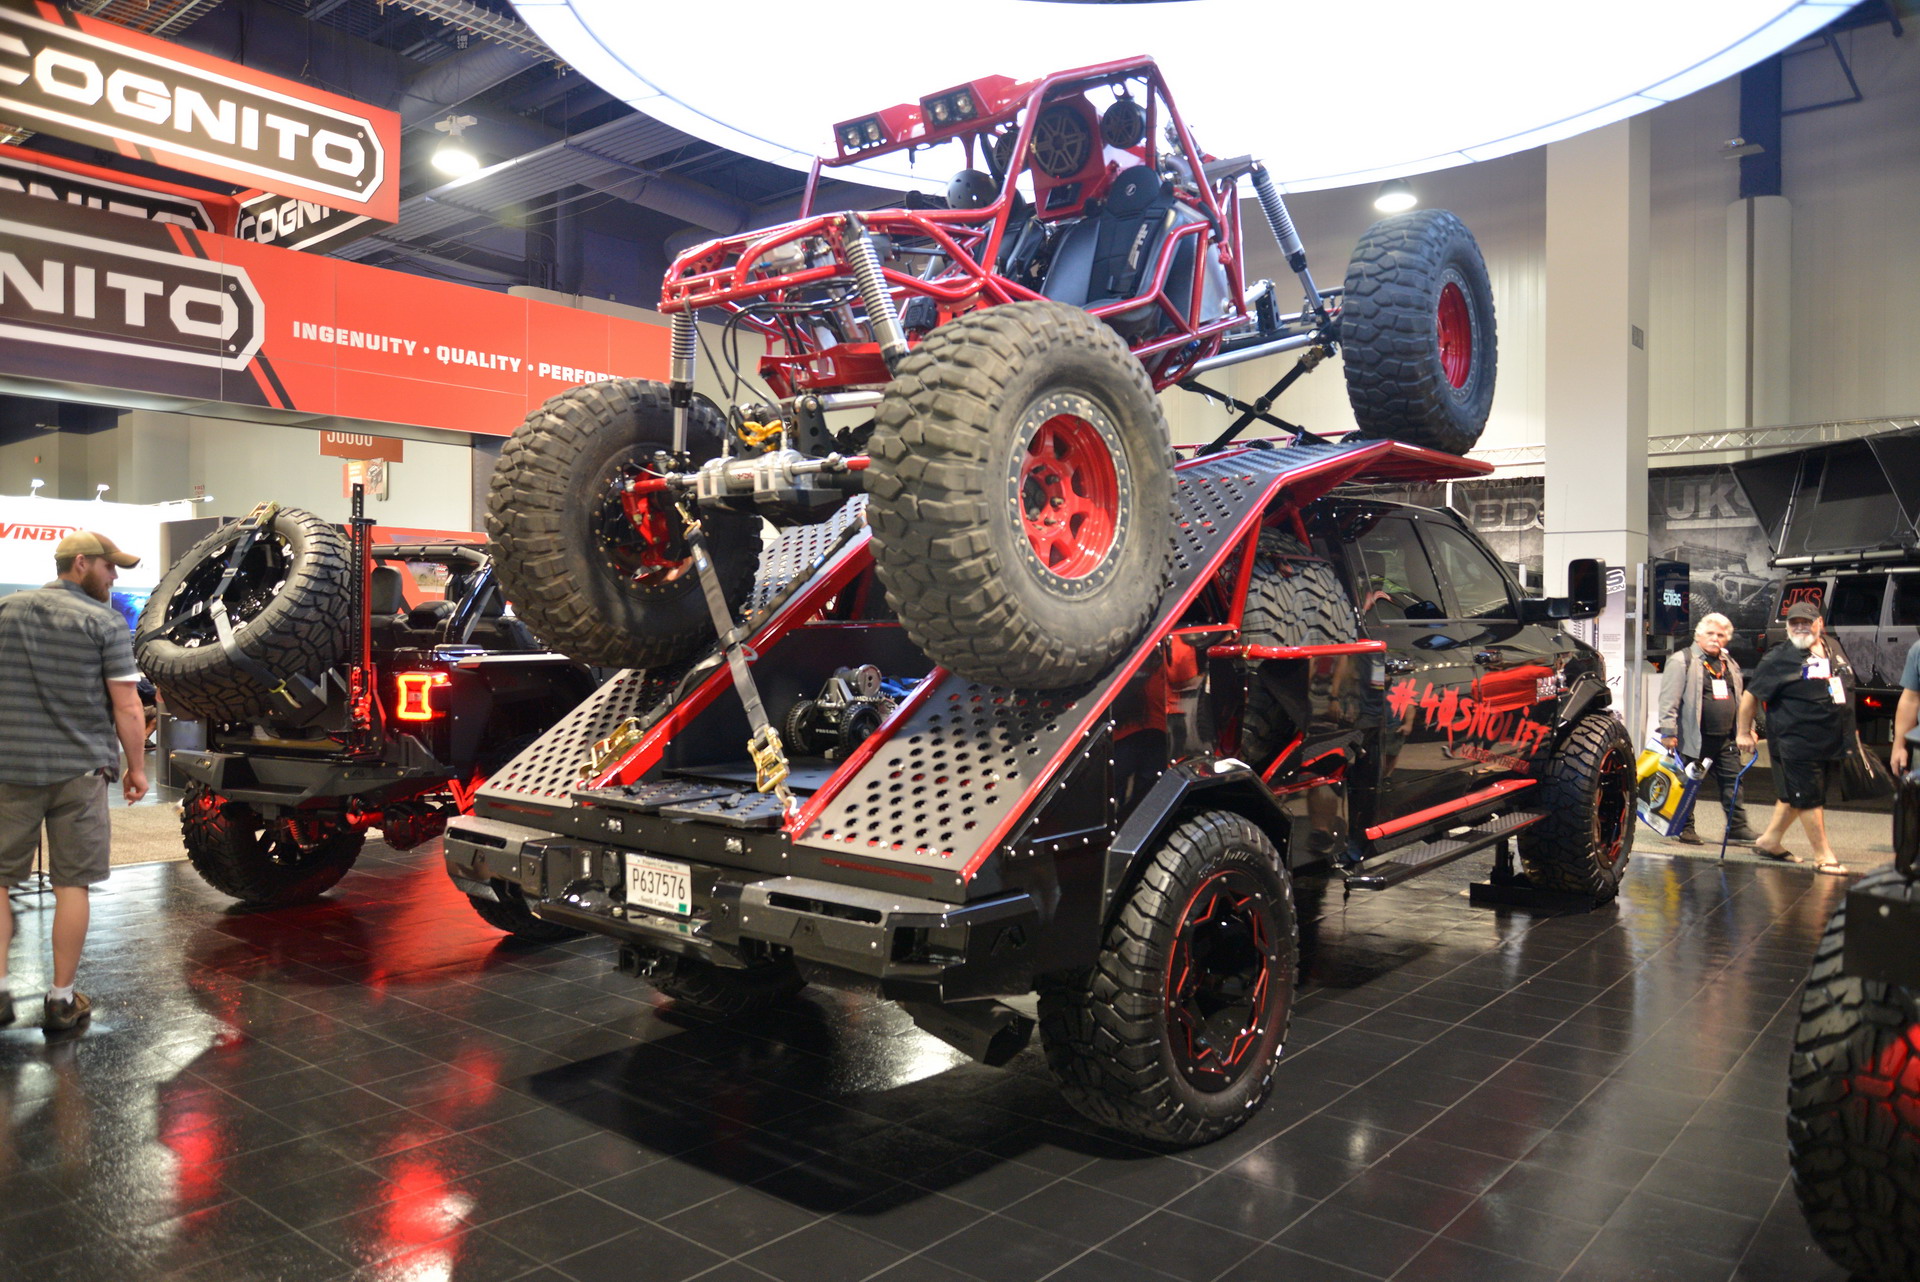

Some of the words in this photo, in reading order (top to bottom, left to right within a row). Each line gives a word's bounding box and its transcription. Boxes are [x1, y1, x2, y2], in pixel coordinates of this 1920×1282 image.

[240, 199, 340, 243] COGNI
[293, 321, 417, 356] INGENUITY
[436, 345, 521, 373] QUALITY
[1782, 587, 1822, 610] JKS
[632, 868, 686, 900] P637576
